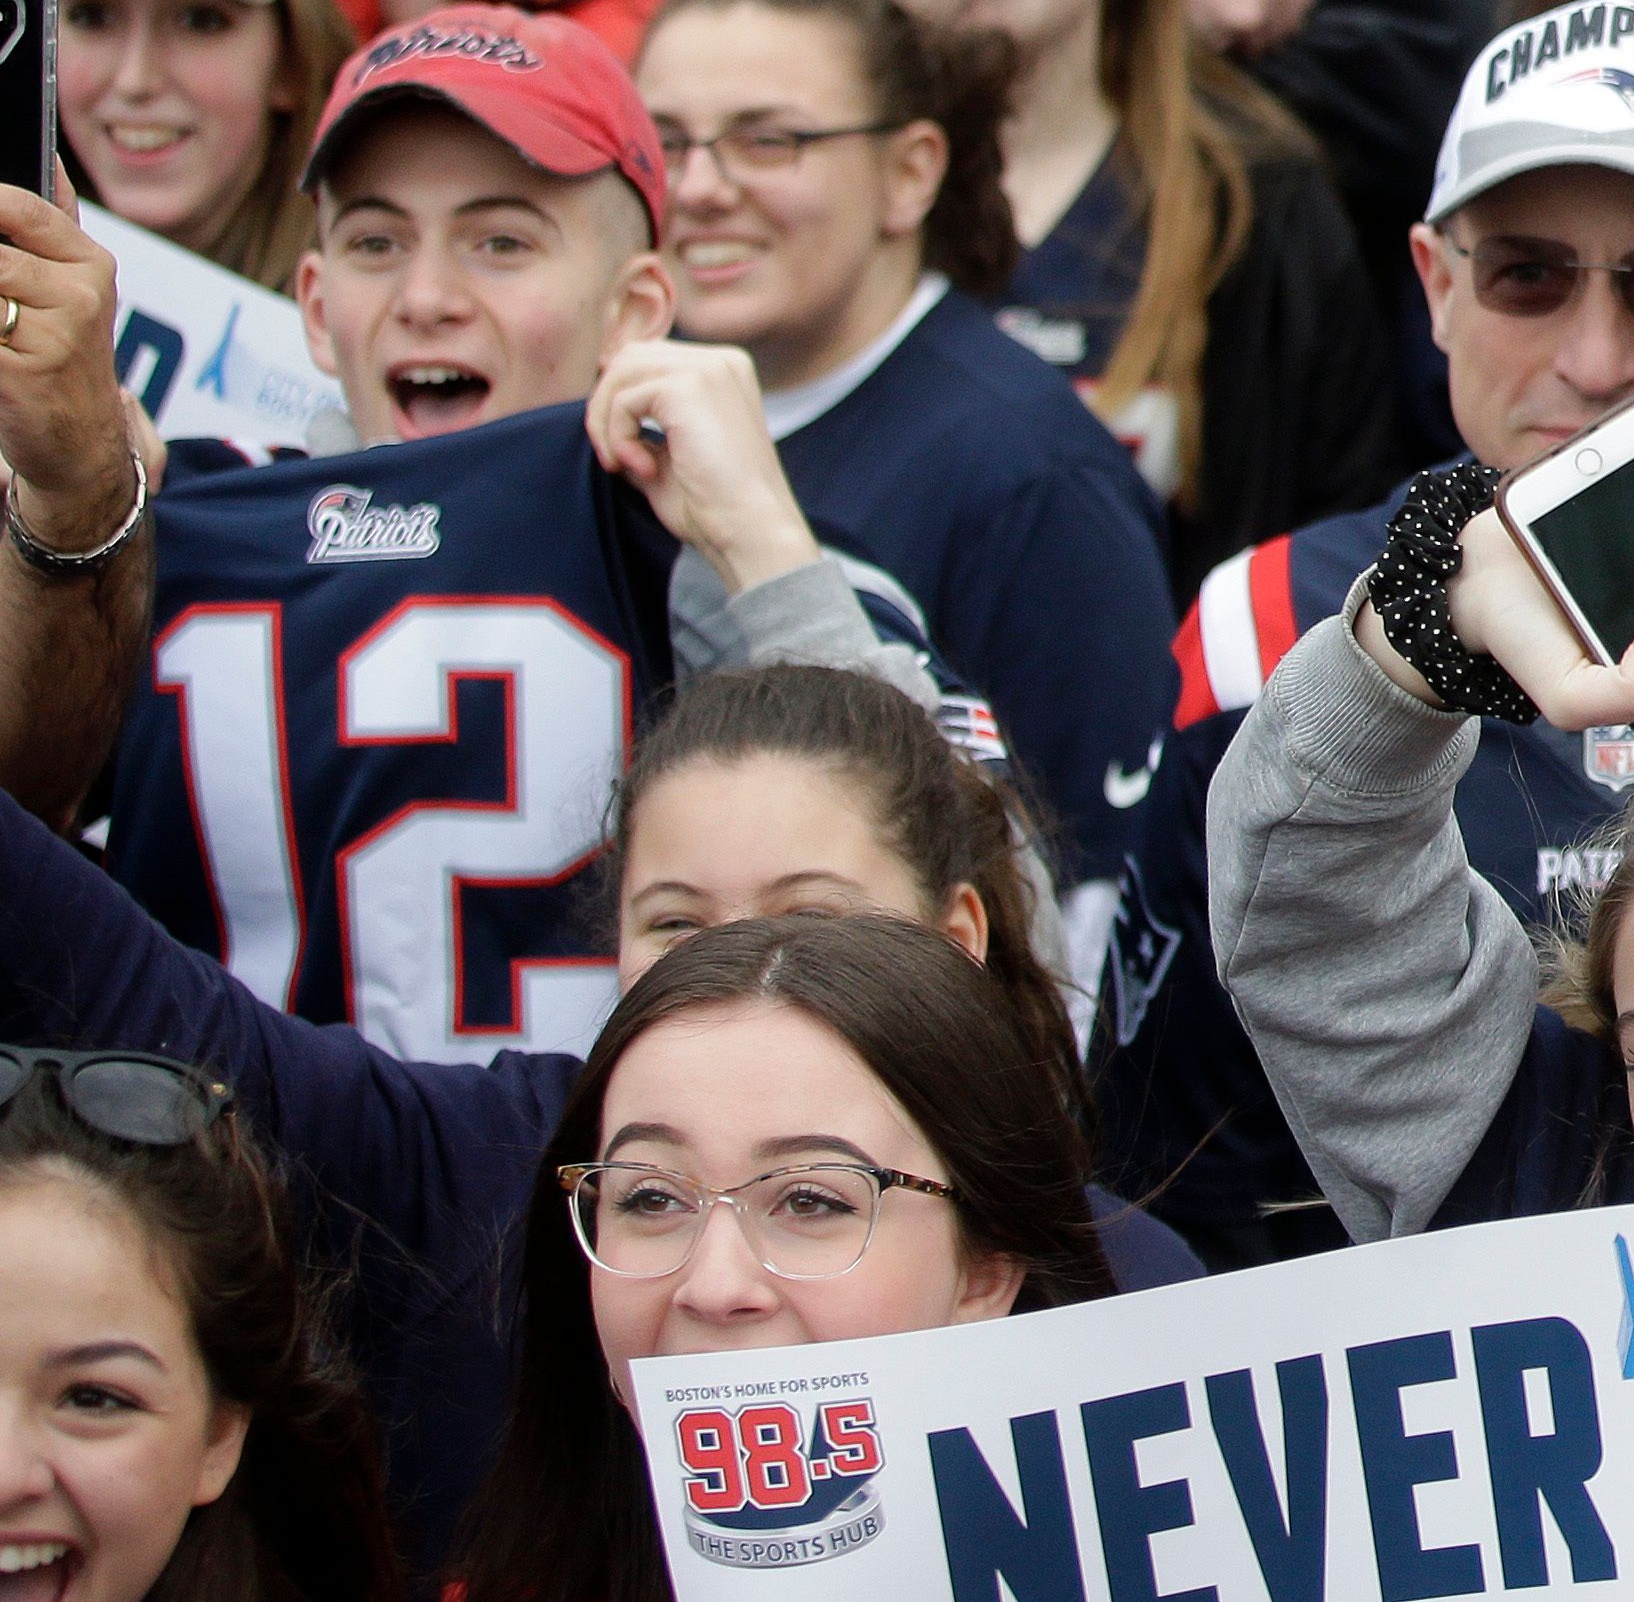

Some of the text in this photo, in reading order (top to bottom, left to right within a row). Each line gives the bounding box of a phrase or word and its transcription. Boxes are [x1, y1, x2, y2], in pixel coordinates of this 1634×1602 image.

[307, 485, 442, 565] Patriots
[152, 594, 633, 1066] 12
[666, 1372, 870, 1403] BOSTON'S HOME FOR SPORTS
[674, 1397, 888, 1515] 98.5
[926, 1316, 1619, 1602] NEVER
[693, 1515, 880, 1563] THE SPORTS HUB
